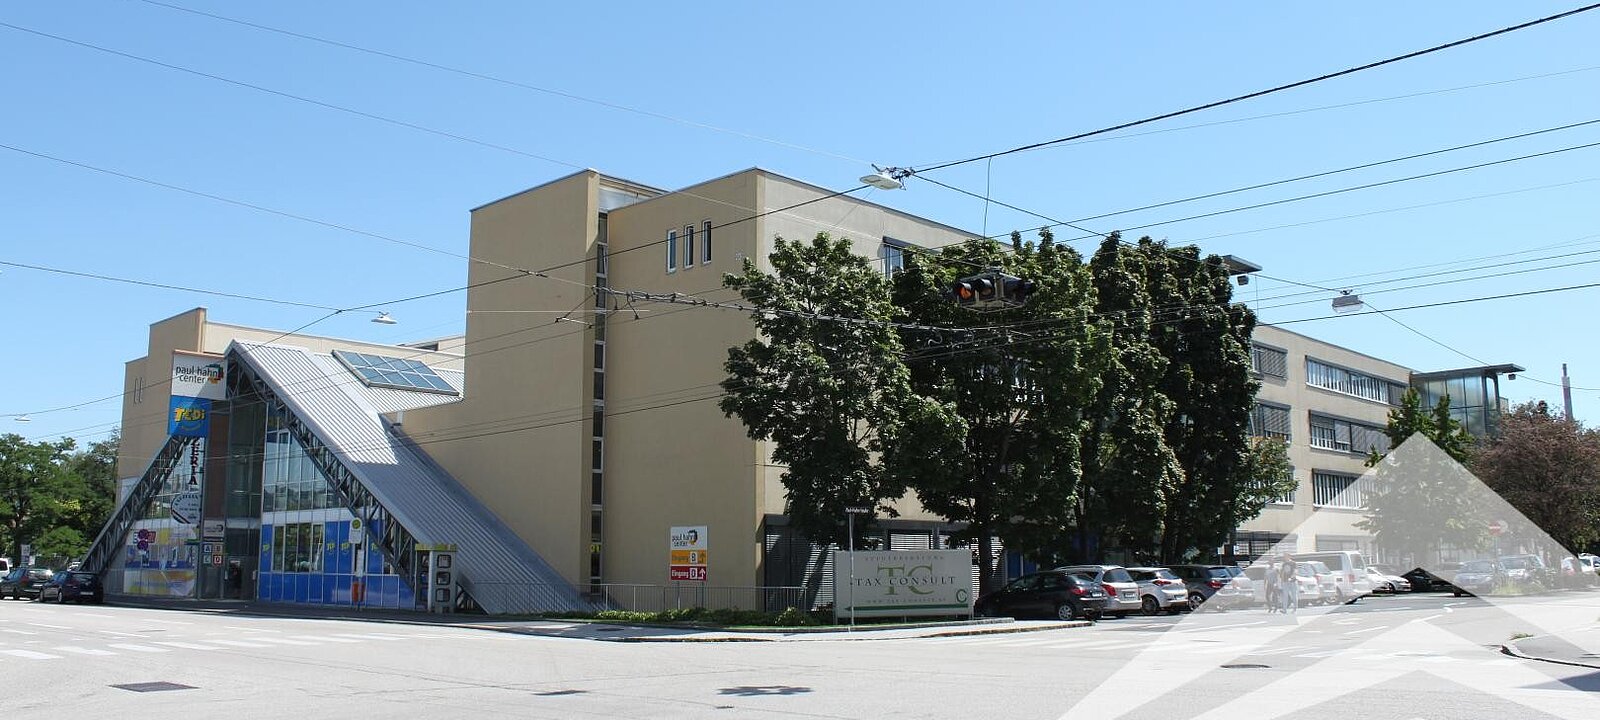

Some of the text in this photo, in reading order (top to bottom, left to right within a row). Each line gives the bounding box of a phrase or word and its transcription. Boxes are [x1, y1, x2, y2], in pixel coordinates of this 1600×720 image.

[175, 366, 218, 377] paul hahn
[179, 374, 206, 384] center
[855, 576, 956, 587] TAX CONSULT
[877, 563, 934, 595] TC
